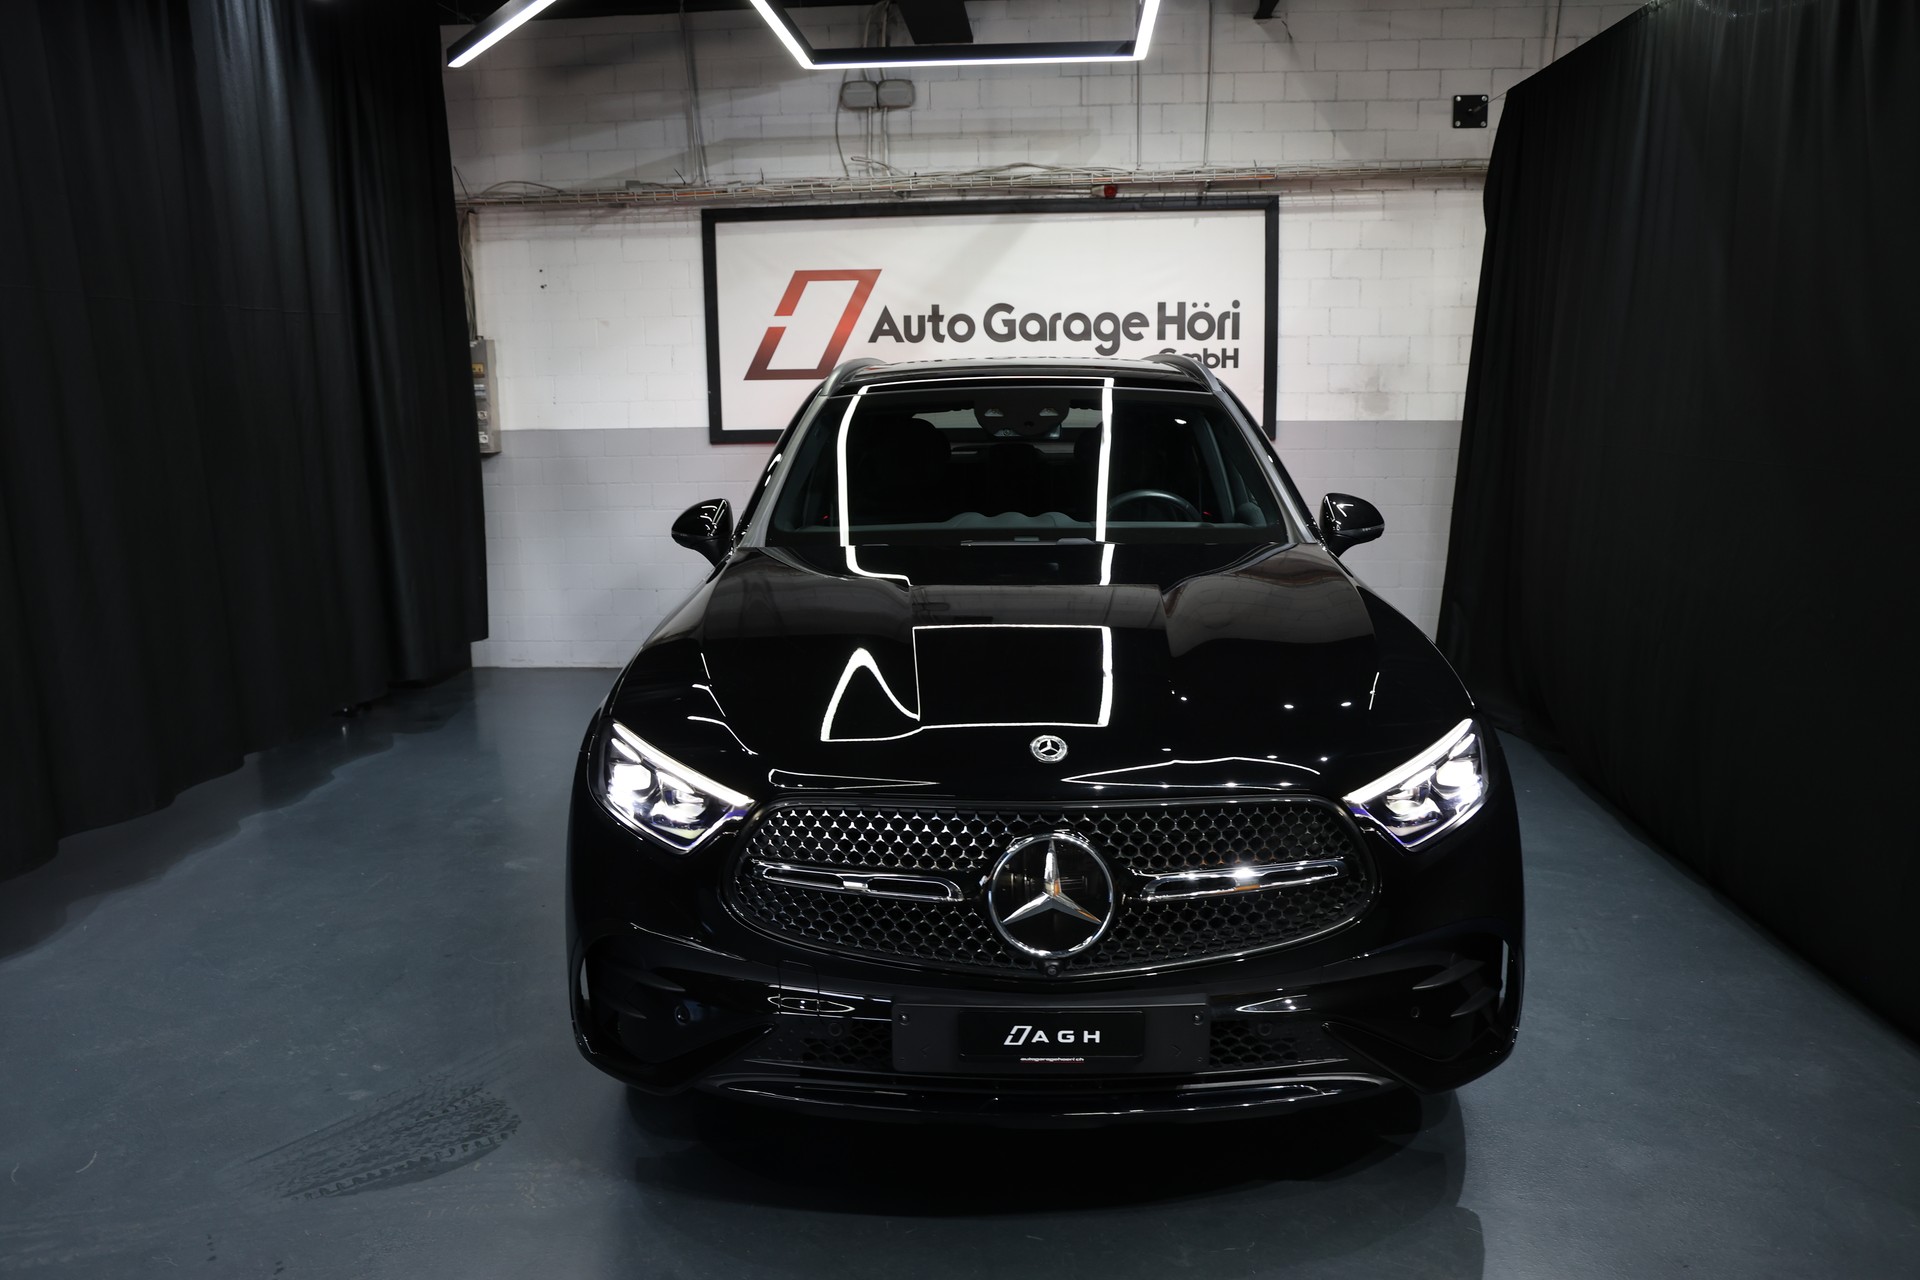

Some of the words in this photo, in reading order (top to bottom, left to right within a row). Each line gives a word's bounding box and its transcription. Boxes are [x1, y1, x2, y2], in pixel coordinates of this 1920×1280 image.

[868, 304, 976, 343] Auto
[983, 302, 1150, 356] Garage
[1156, 299, 1241, 341] Höri
[1031, 1030, 1100, 1043] AGH
